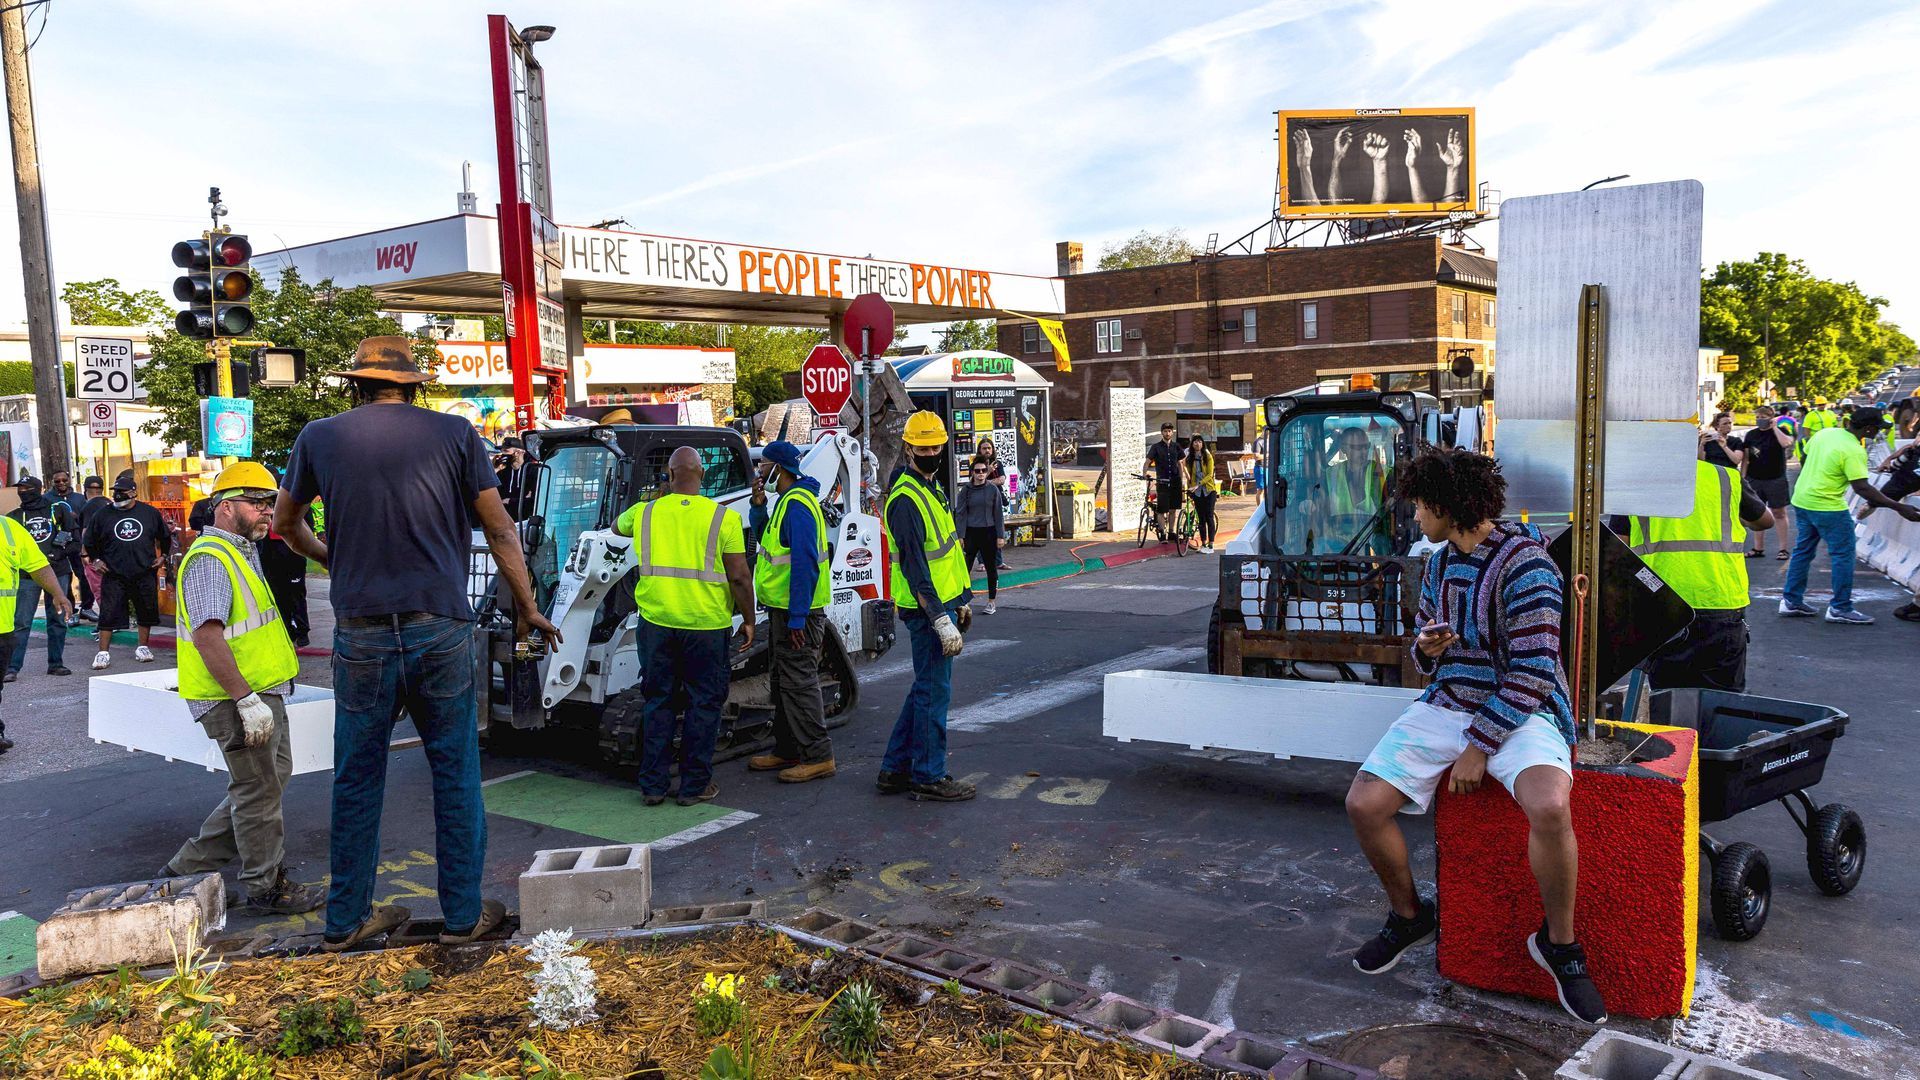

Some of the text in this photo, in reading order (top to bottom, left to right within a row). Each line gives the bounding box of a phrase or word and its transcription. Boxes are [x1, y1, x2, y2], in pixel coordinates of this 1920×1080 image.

[1449, 211, 1476, 219] 032480
[376, 241, 418, 273] way
[640, 239, 728, 286] THERE'S
[739, 251, 842, 298] PEOPLE
[847, 262, 907, 298] THERE'S
[910, 263, 995, 309] POWER
[80, 344, 128, 356] SPEED
[86, 357, 123, 368] LIMIT
[83, 370, 128, 393] 20
[806, 367, 848, 394] STOP
[955, 390, 977, 398] GEORGE
[995, 389, 1015, 397] SQUARE
[820, 416, 837, 425] ALL WAY
[846, 522, 858, 541] 2
[846, 568, 873, 582] Bobcat
[833, 591, 853, 605] T595
[1768, 750, 1809, 769] GORILLA CARTS
